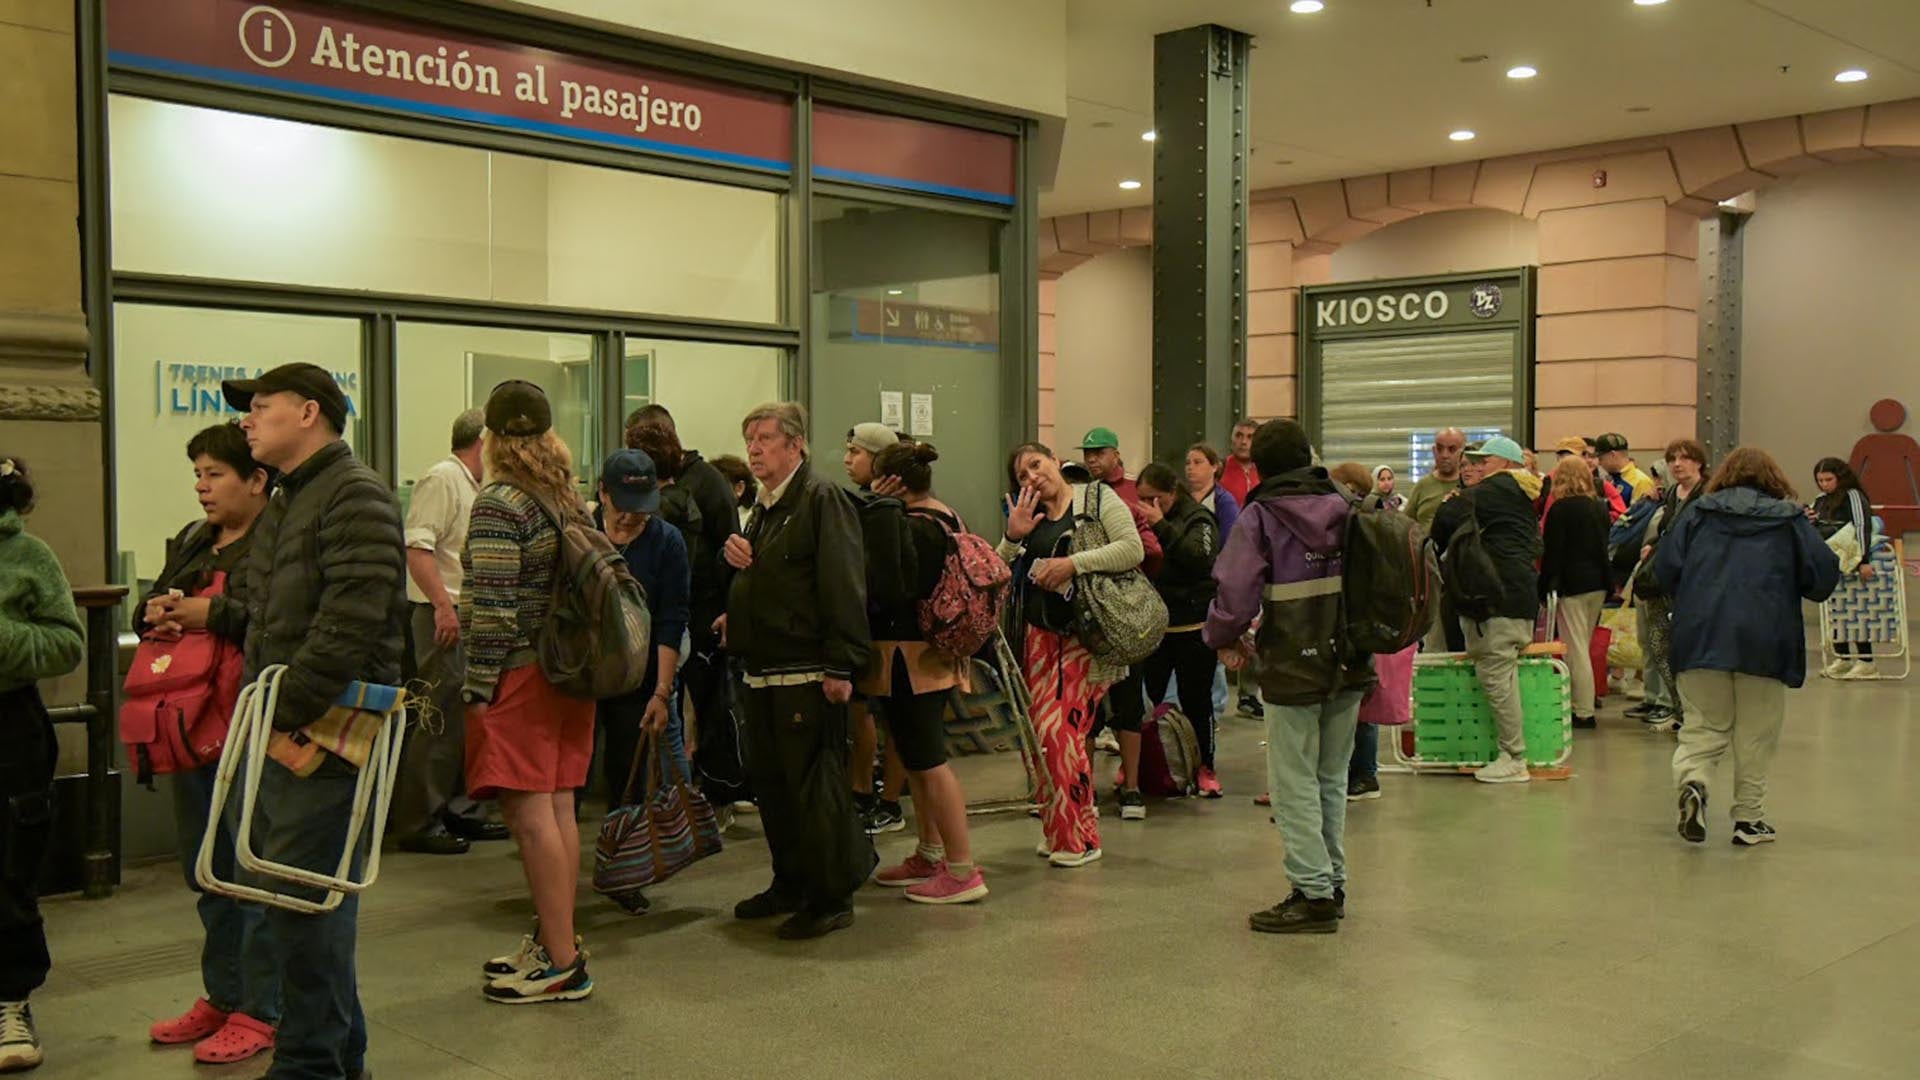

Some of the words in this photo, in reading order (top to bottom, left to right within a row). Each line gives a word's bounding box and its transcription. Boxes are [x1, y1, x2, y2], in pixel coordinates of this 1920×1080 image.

[311, 26, 501, 96] Atención
[515, 65, 548, 105] al
[560, 80, 702, 133] pasajero
[1317, 290, 1449, 327] KIOSCO
[169, 363, 248, 383] TRENES
[172, 381, 240, 415] LÍN
